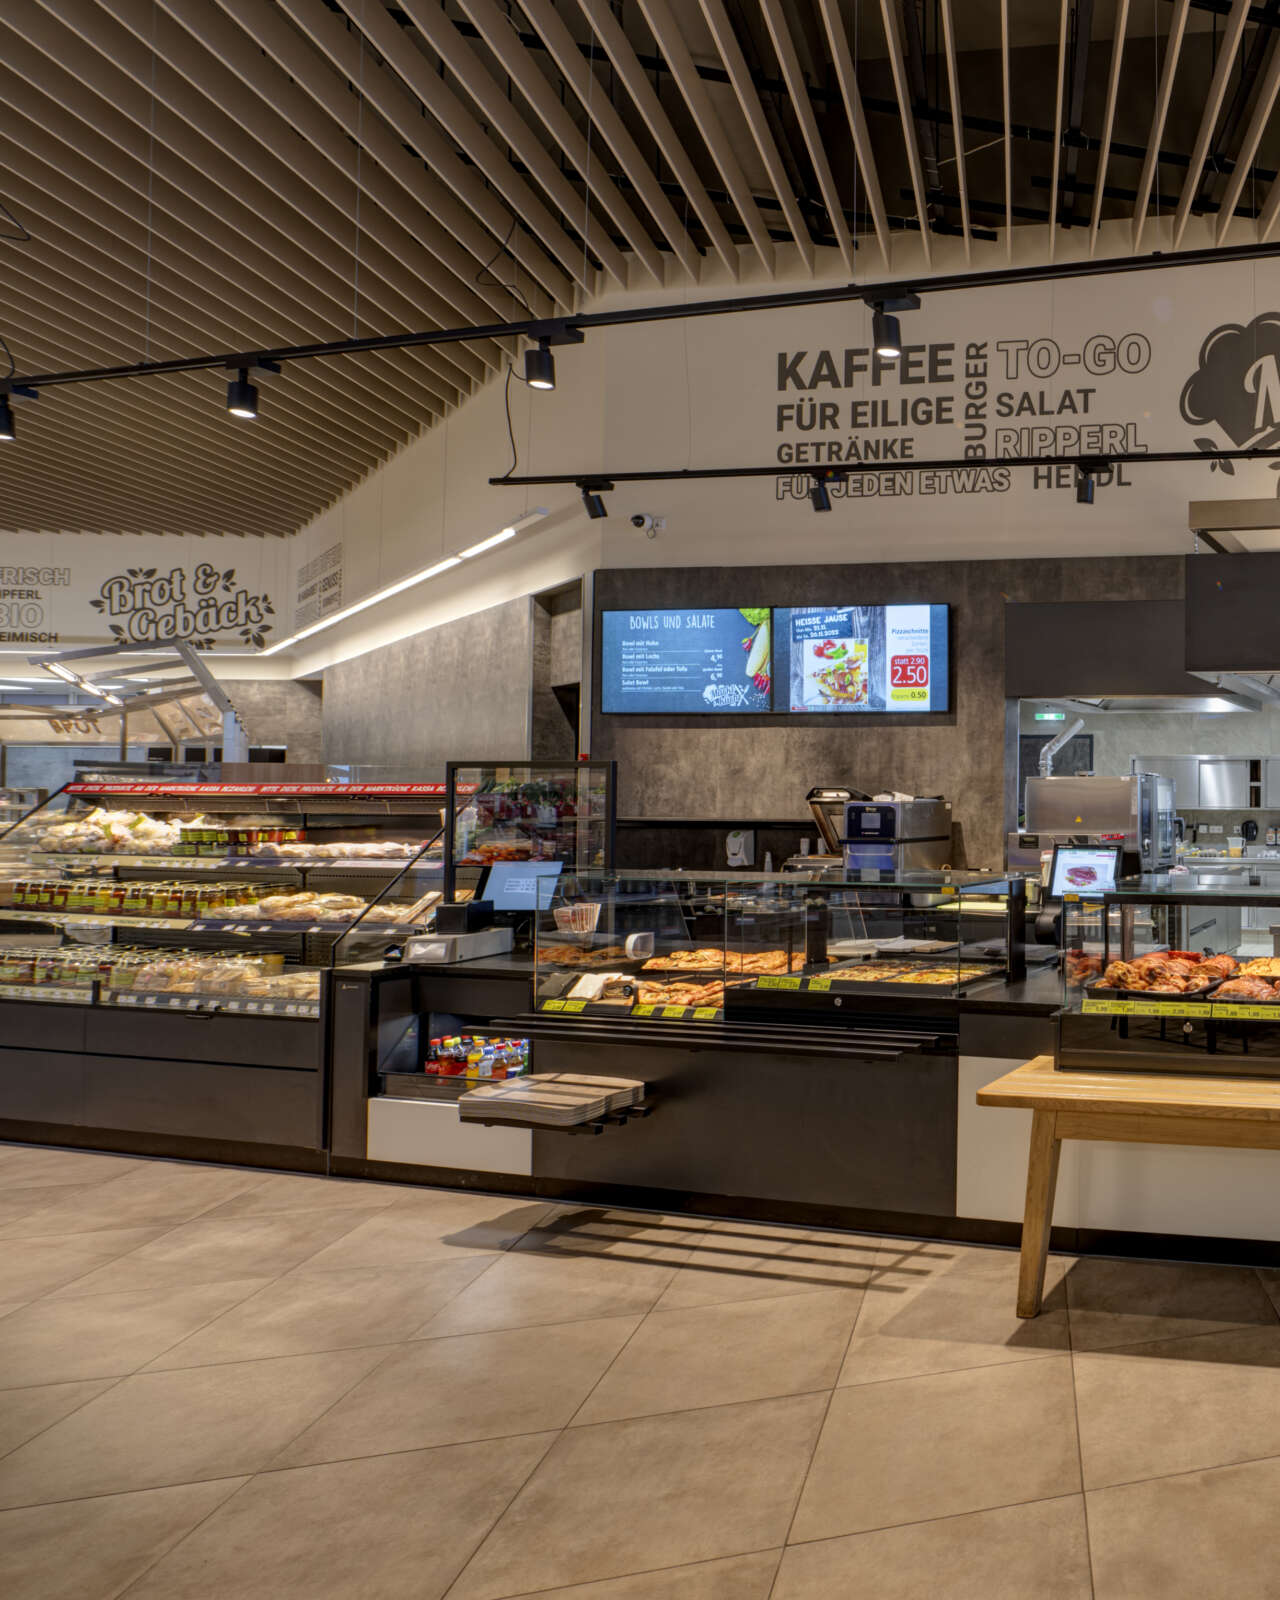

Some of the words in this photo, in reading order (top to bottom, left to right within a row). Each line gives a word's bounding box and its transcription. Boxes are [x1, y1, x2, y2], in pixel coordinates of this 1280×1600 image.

[777, 343, 955, 391] KAFFEE
[997, 333, 1152, 379] TO-GO
[777, 398, 840, 431] FÜR
[851, 397, 954, 429] EILIGE
[964, 341, 988, 460] BURGER
[996, 388, 1096, 417] SALAT
[777, 436, 914, 463] GETRÄNKE
[995, 423, 1148, 459] RIPPERL
[919, 467, 1011, 494] ETWAS
[101, 568, 186, 616] Brot
[193, 563, 221, 595] &
[128, 590, 264, 642] Gebäck
[630, 615, 659, 630] BOWLS
[664, 615, 681, 629] UND
[686, 614, 715, 629] SALATE
[892, 665, 927, 684] 2.50
[910, 657, 926, 665] 2.90
